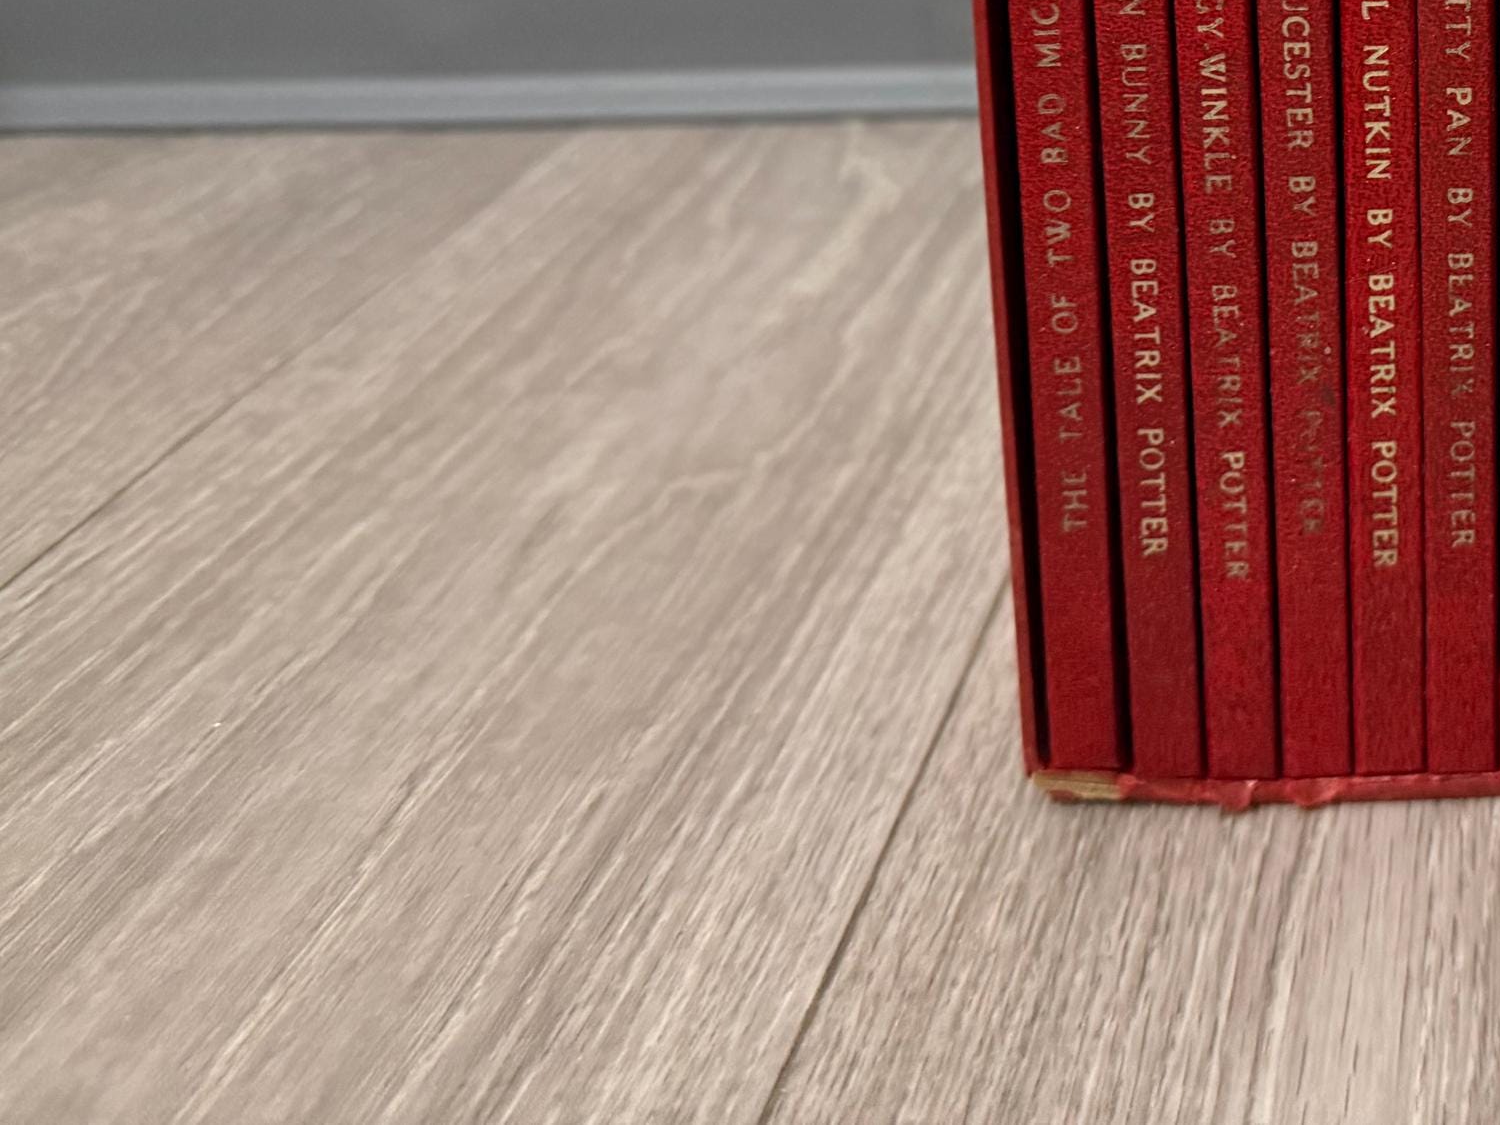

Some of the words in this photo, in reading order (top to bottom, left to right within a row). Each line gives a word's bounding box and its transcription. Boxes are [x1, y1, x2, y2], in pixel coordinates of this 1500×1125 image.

[1038, 93, 1068, 164] BAD
[1120, 43, 1152, 164] BUNNY
[1362, 45, 1392, 180] NUTKIN
[1446, 86, 1472, 156] PAN
[1043, 189, 1074, 267] TWO
[1128, 192, 1155, 233] BY
[1209, 218, 1236, 258] BY
[1288, 176, 1316, 217] BY
[1366, 208, 1393, 249] BY
[1447, 187, 1473, 228] BY
[1051, 293, 1078, 333] OF
[1130, 259, 1162, 404] BEATRIX
[1212, 284, 1242, 428] BEATRIX
[1368, 274, 1397, 419] BEATRIX
[1448, 252, 1475, 396] BEATRIX
[1055, 356, 1083, 443] TALE
[1061, 470, 1088, 533] THE
[1138, 428, 1168, 556] POTTER
[1220, 452, 1249, 579] POTTER
[1371, 440, 1398, 568] POTTER
[1450, 421, 1475, 547] POTTER
